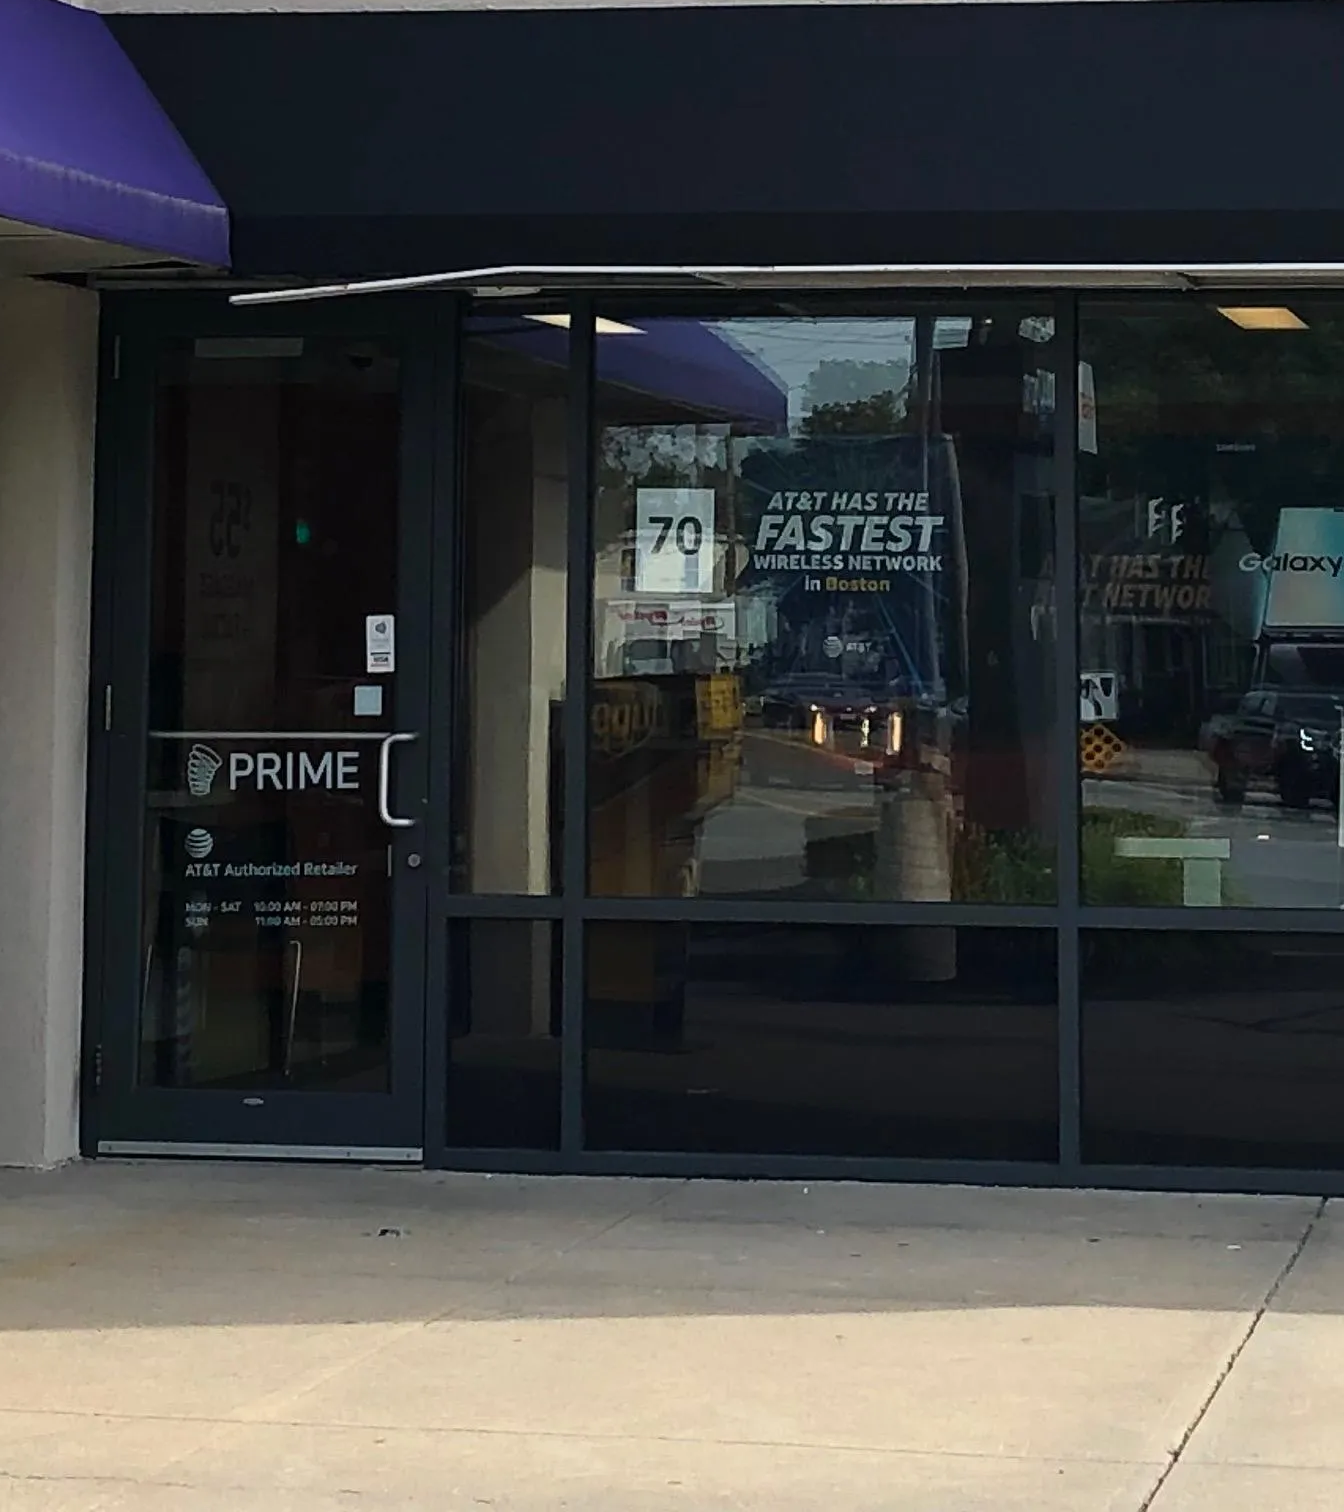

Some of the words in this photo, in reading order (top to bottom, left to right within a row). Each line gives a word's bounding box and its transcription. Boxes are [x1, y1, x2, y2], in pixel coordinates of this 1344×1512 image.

[767, 491, 827, 512] AT&T
[830, 491, 882, 512] HAS
[884, 491, 930, 512] THE
[648, 515, 703, 556] 70
[755, 514, 945, 553] FASTEST
[753, 554, 845, 572] WIRELESS
[847, 554, 943, 572] NETWORK
[1238, 551, 1344, 578] Galaxy
[804, 575, 821, 592] in
[825, 575, 891, 592] Boston
[228, 751, 360, 790] PRIME
[185, 863, 221, 877] AT&T
[223, 861, 301, 877] Authorized
[303, 861, 359, 877] Retailer
[220, 901, 243, 913] SAT
